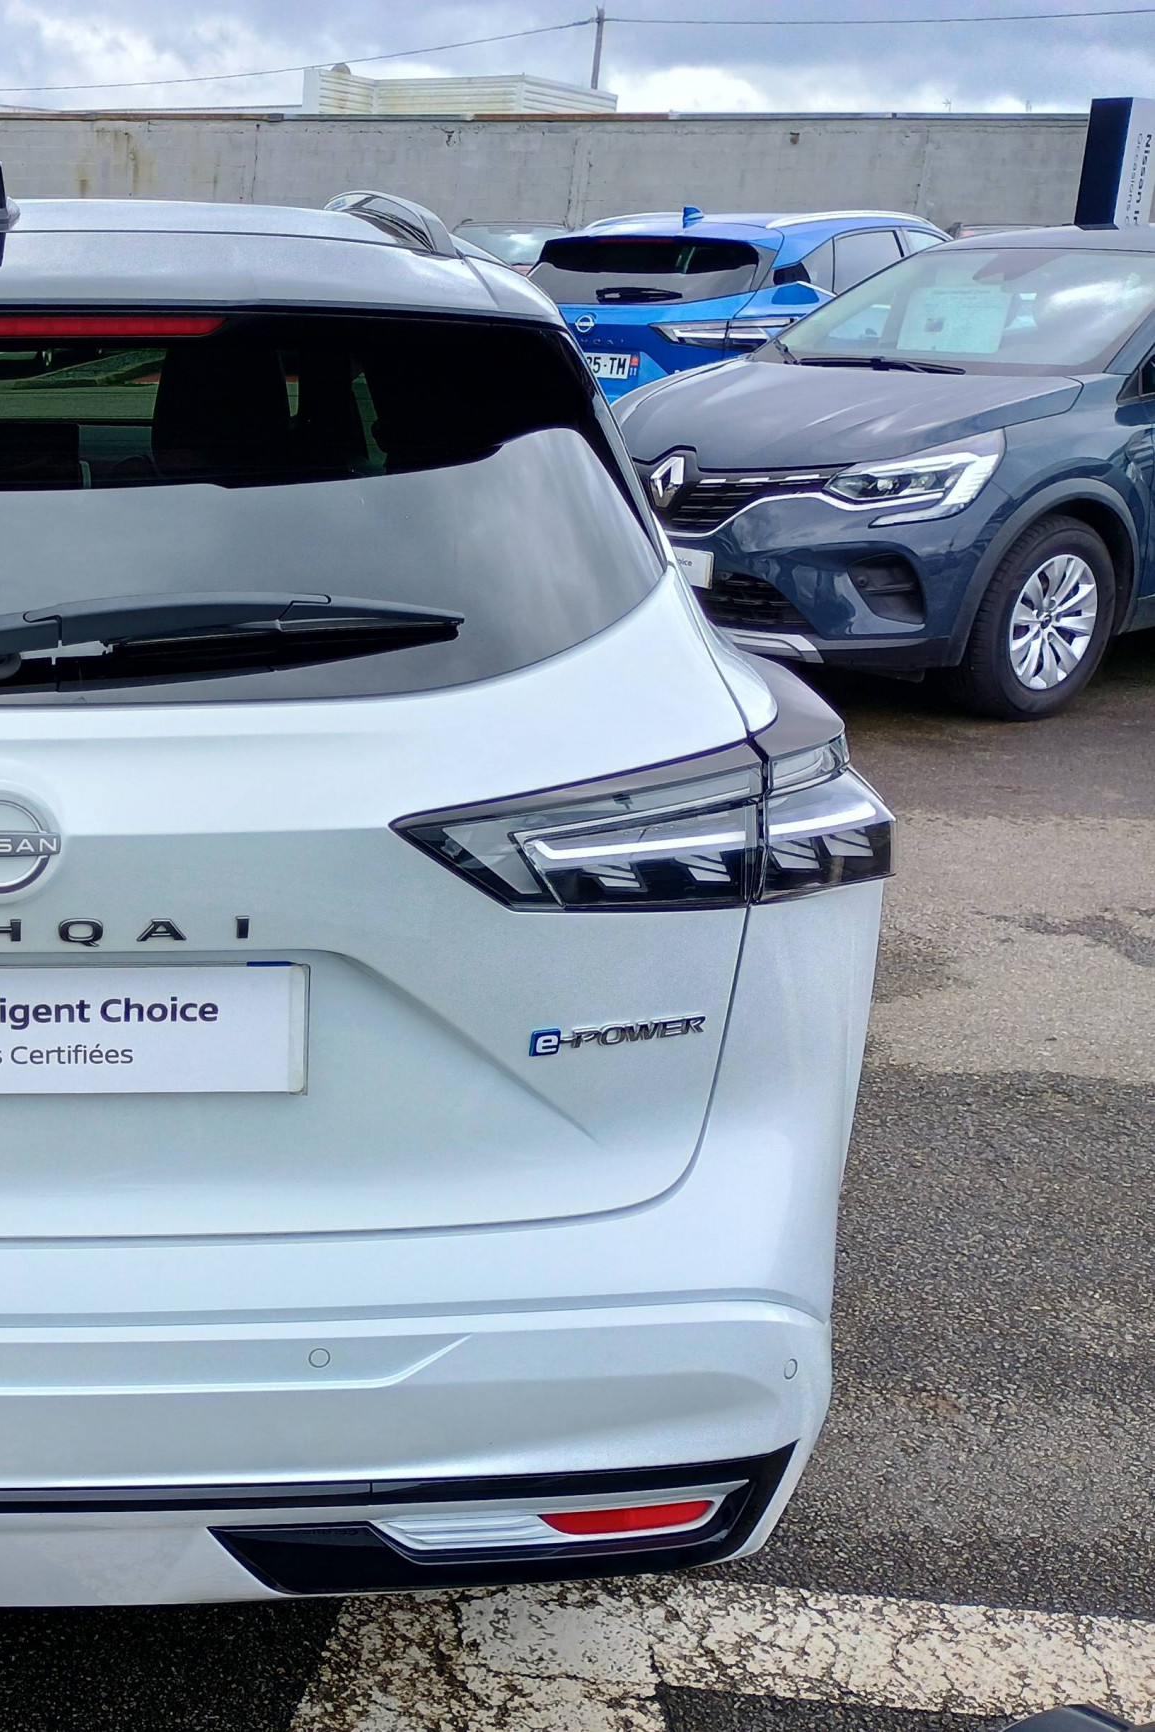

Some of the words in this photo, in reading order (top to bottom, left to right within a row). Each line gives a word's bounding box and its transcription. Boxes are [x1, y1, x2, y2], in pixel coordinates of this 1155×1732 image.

[1135, 133, 1153, 204] Nissan
[100, 996, 220, 1024] Choice
[529, 1013, 706, 1057] e-POWER
[10, 1043, 134, 1067] Certifiées
